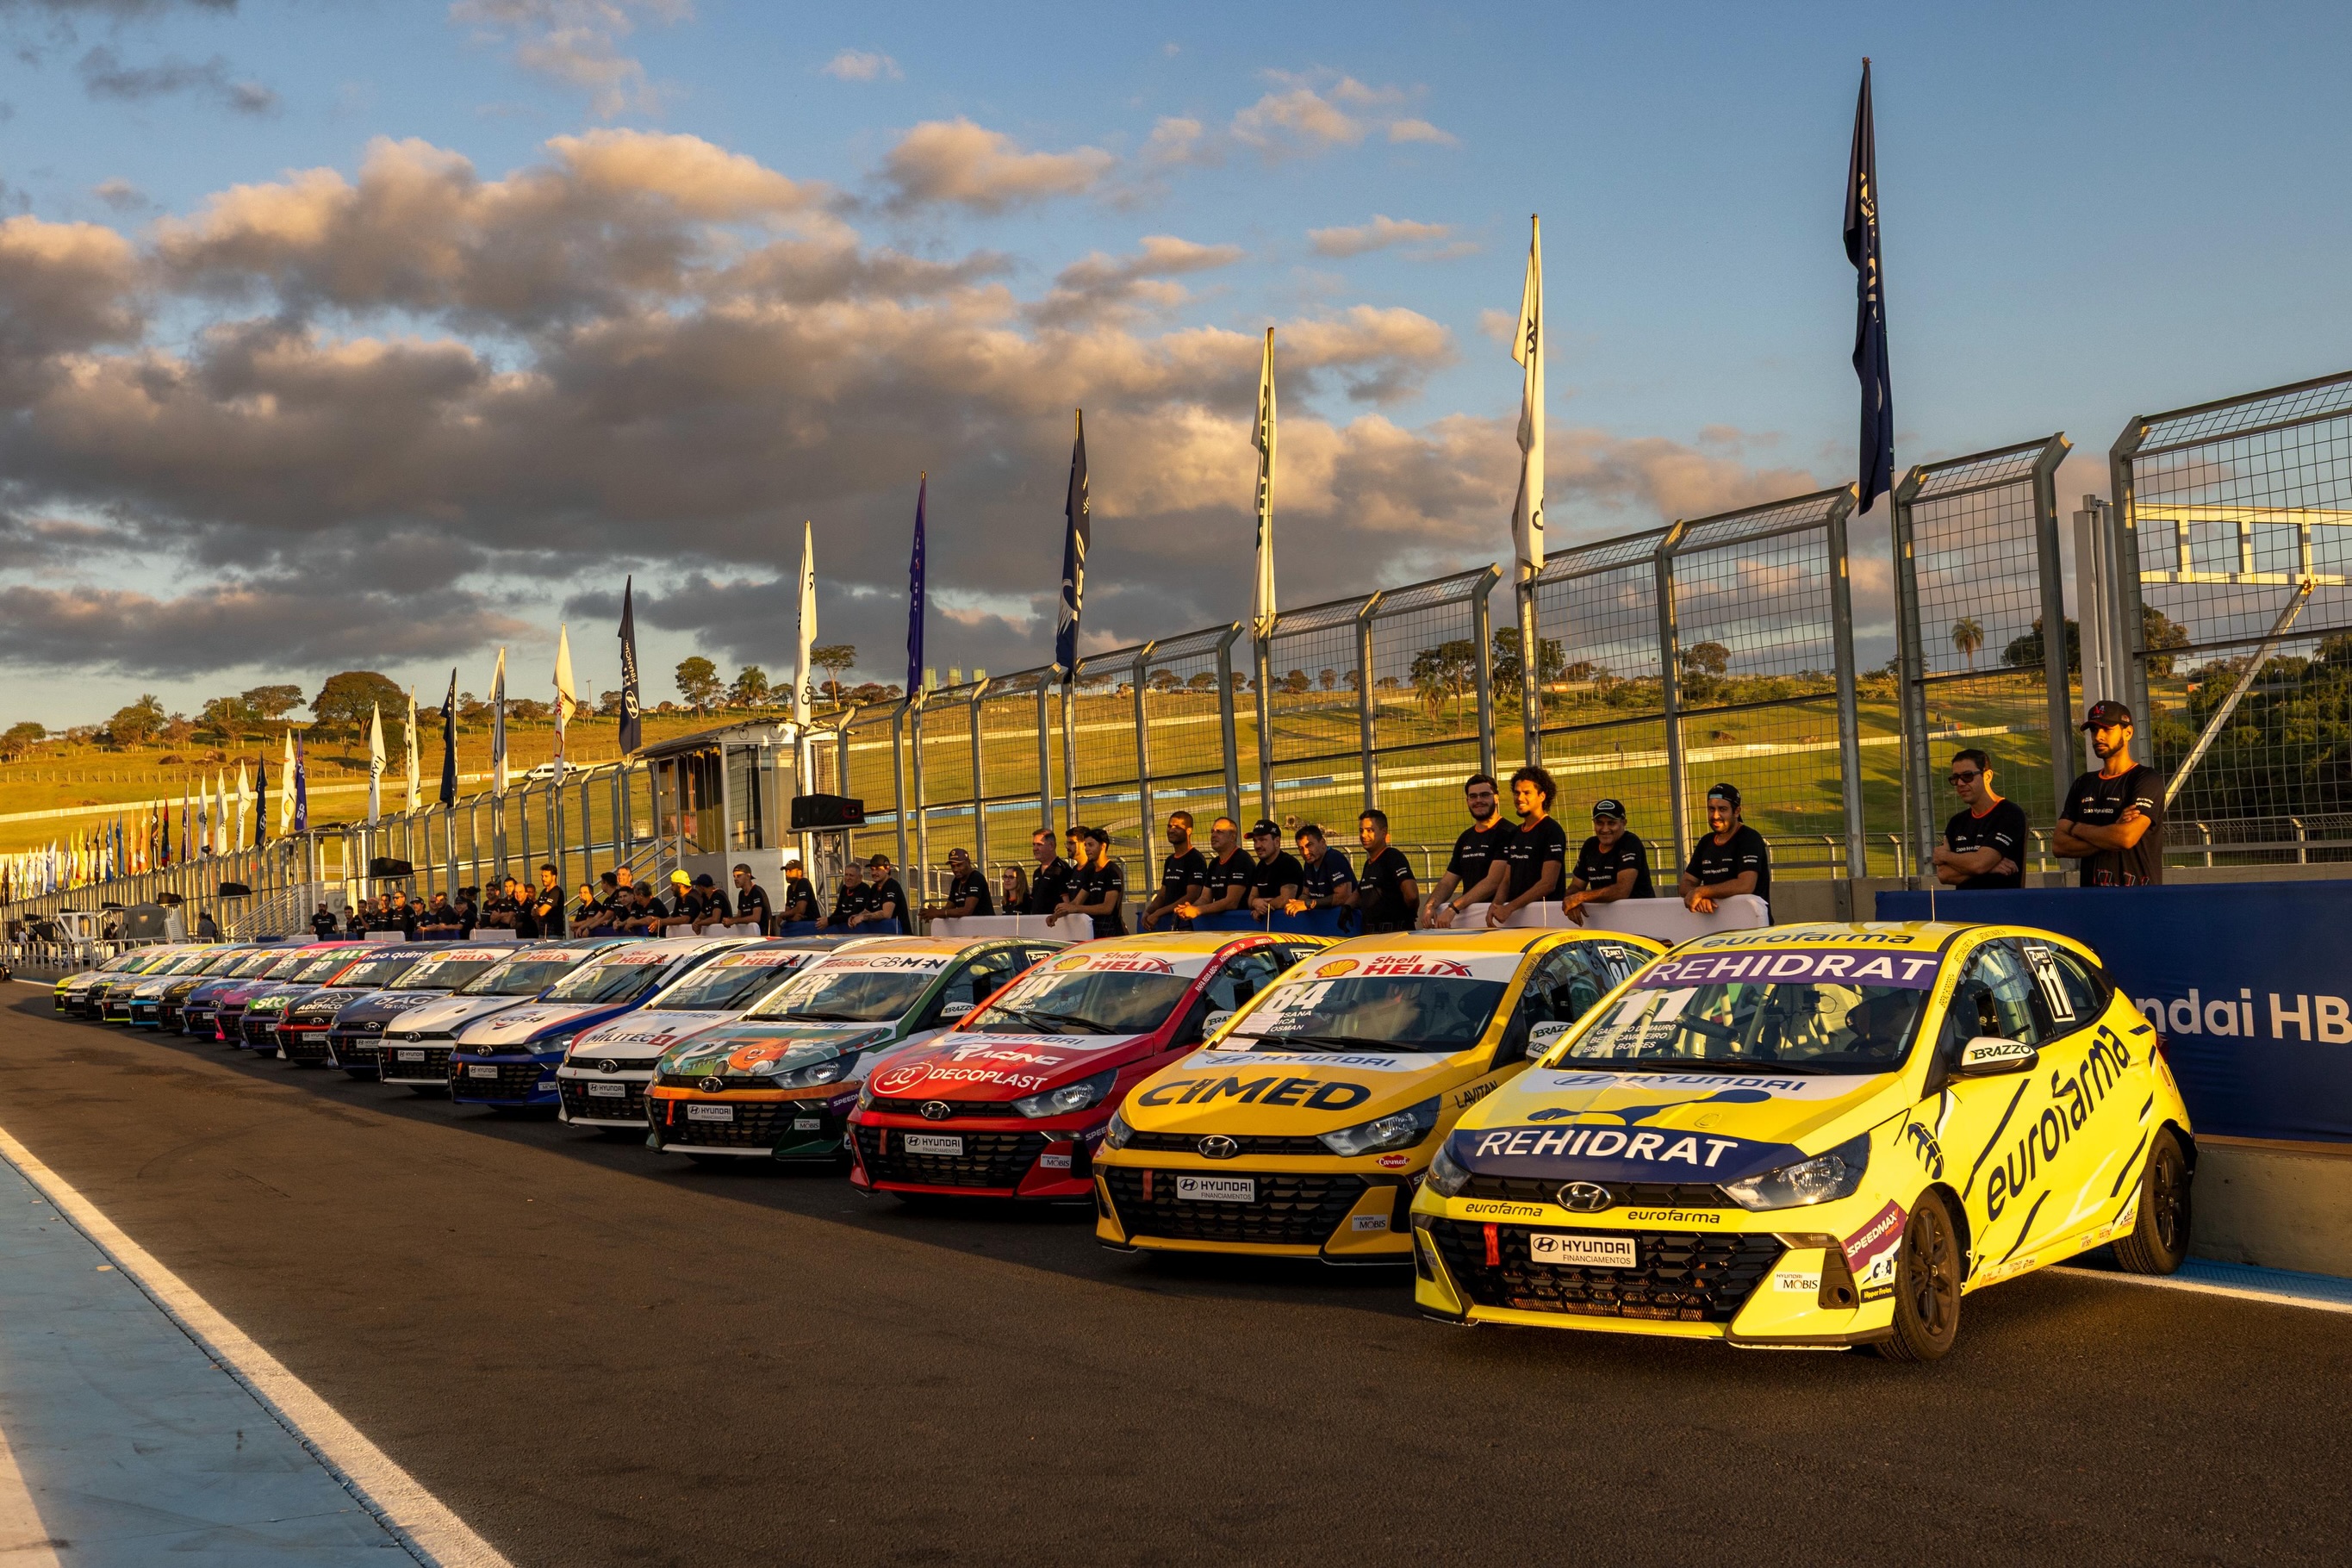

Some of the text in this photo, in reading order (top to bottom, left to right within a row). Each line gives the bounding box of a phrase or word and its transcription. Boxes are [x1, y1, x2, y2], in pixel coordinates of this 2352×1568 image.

[1702, 931, 1916, 949] eurofarma
[350, 961, 377, 974] 18
[1088, 960, 1175, 974] HELIX
[1362, 959, 1472, 977] HELIX
[1372, 955, 1423, 965] Shell
[1642, 955, 1938, 984] REHIDRAT
[1004, 974, 1068, 1002] 301
[2038, 963, 2073, 1017] 11
[1260, 980, 1335, 1014] 84
[1611, 987, 1699, 1025] 11
[585, 1033, 653, 1044] MILITEC
[1596, 1026, 1635, 1036] GAETNO
[1616, 1032, 1668, 1042] CAVAEIRO
[982, 1035, 1086, 1046] HYUNDAI
[1259, 1055, 1397, 1067] HYUNDAI
[1974, 1045, 2032, 1061] BRAZZO
[929, 1067, 1048, 1091] DECOPLAST
[1623, 1073, 1808, 1092] HYUNDAI
[1139, 1076, 1372, 1111] CIMED
[1453, 1080, 1499, 1109] LAVITAN
[700, 1106, 731, 1116] HYUNDAI
[1987, 1024, 2131, 1223] eurofarma
[922, 1137, 961, 1148] HYUNDAI
[1475, 1129, 1739, 1167] REHIDRAT
[1378, 1157, 1409, 1167] Carmed
[1200, 1180, 1252, 1192] HYUNDAI
[1201, 1192, 1252, 1201] FINANCIAMENTOS
[1465, 1201, 1544, 1218] eurofarma
[1627, 1208, 1721, 1225] eurofarma
[1359, 1220, 1386, 1229] MOBIS
[1846, 1210, 1898, 1258] SPEEDMAX
[1561, 1239, 1632, 1255] HYUNDAI
[1562, 1254, 1632, 1266] FINANCIAMENTOS
[1783, 1279, 1819, 1290] MOBIS
